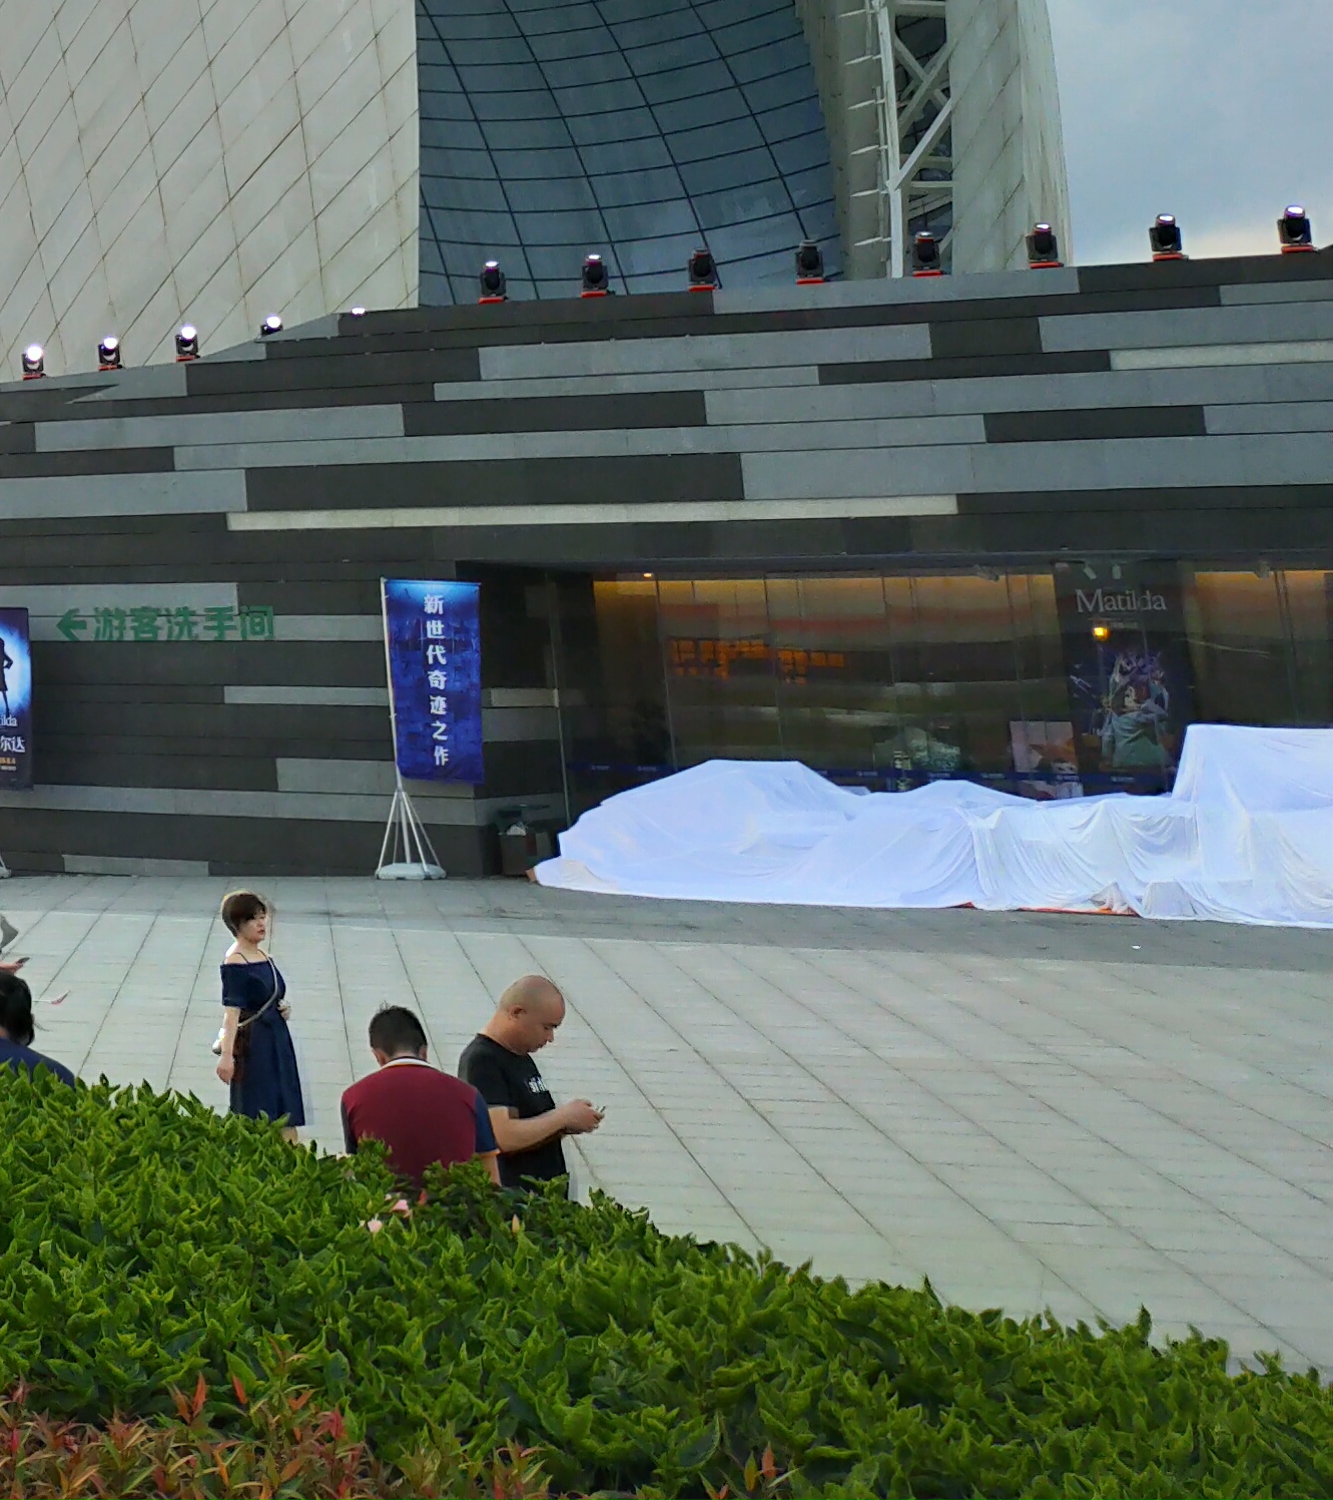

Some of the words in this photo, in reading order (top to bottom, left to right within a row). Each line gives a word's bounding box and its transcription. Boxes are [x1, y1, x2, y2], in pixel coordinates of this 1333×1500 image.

[1075, 588, 1167, 613] Matilda
[93, 605, 275, 641] 游客洗手间
[423, 594, 450, 766] 新世代奇迹之作
